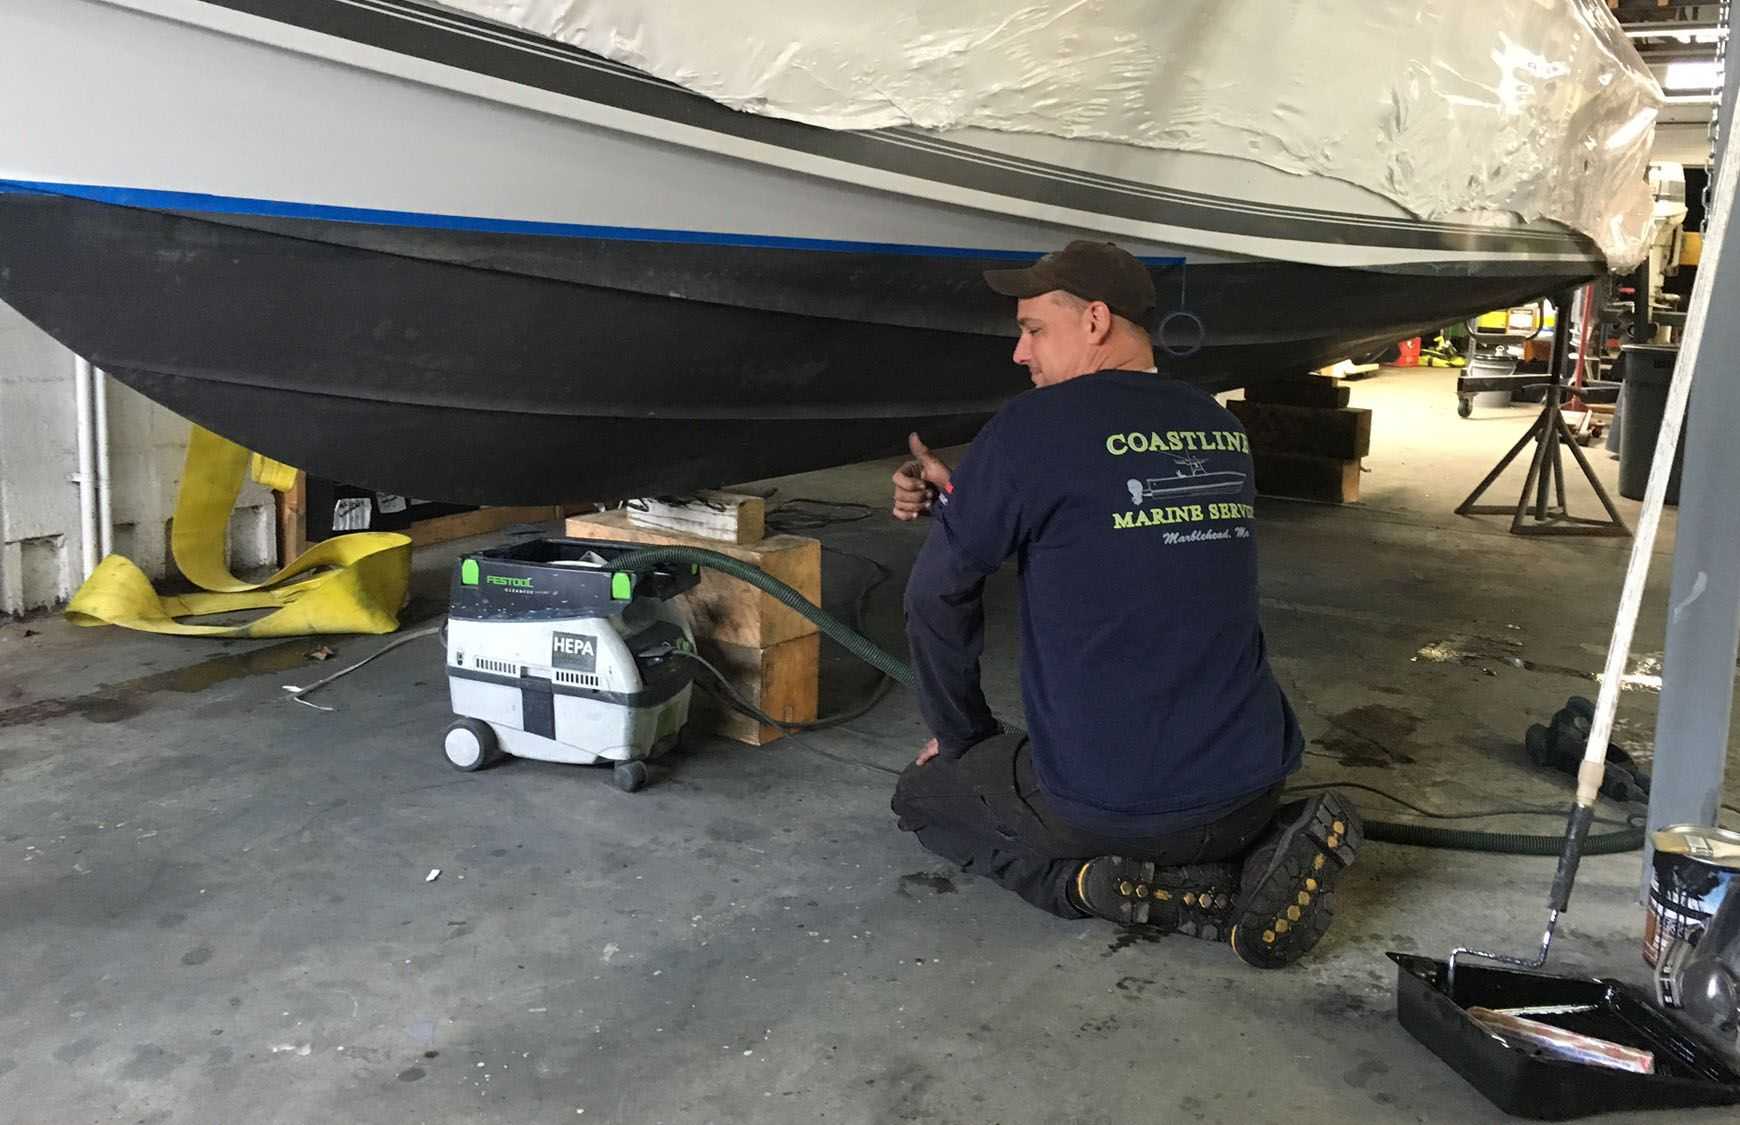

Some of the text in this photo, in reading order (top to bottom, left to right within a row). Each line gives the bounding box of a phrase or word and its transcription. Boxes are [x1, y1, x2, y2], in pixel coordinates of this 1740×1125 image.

[1112, 504, 1204, 529] MARINE
[486, 575, 534, 588] FESTOOL
[554, 636, 594, 657] HEPA
